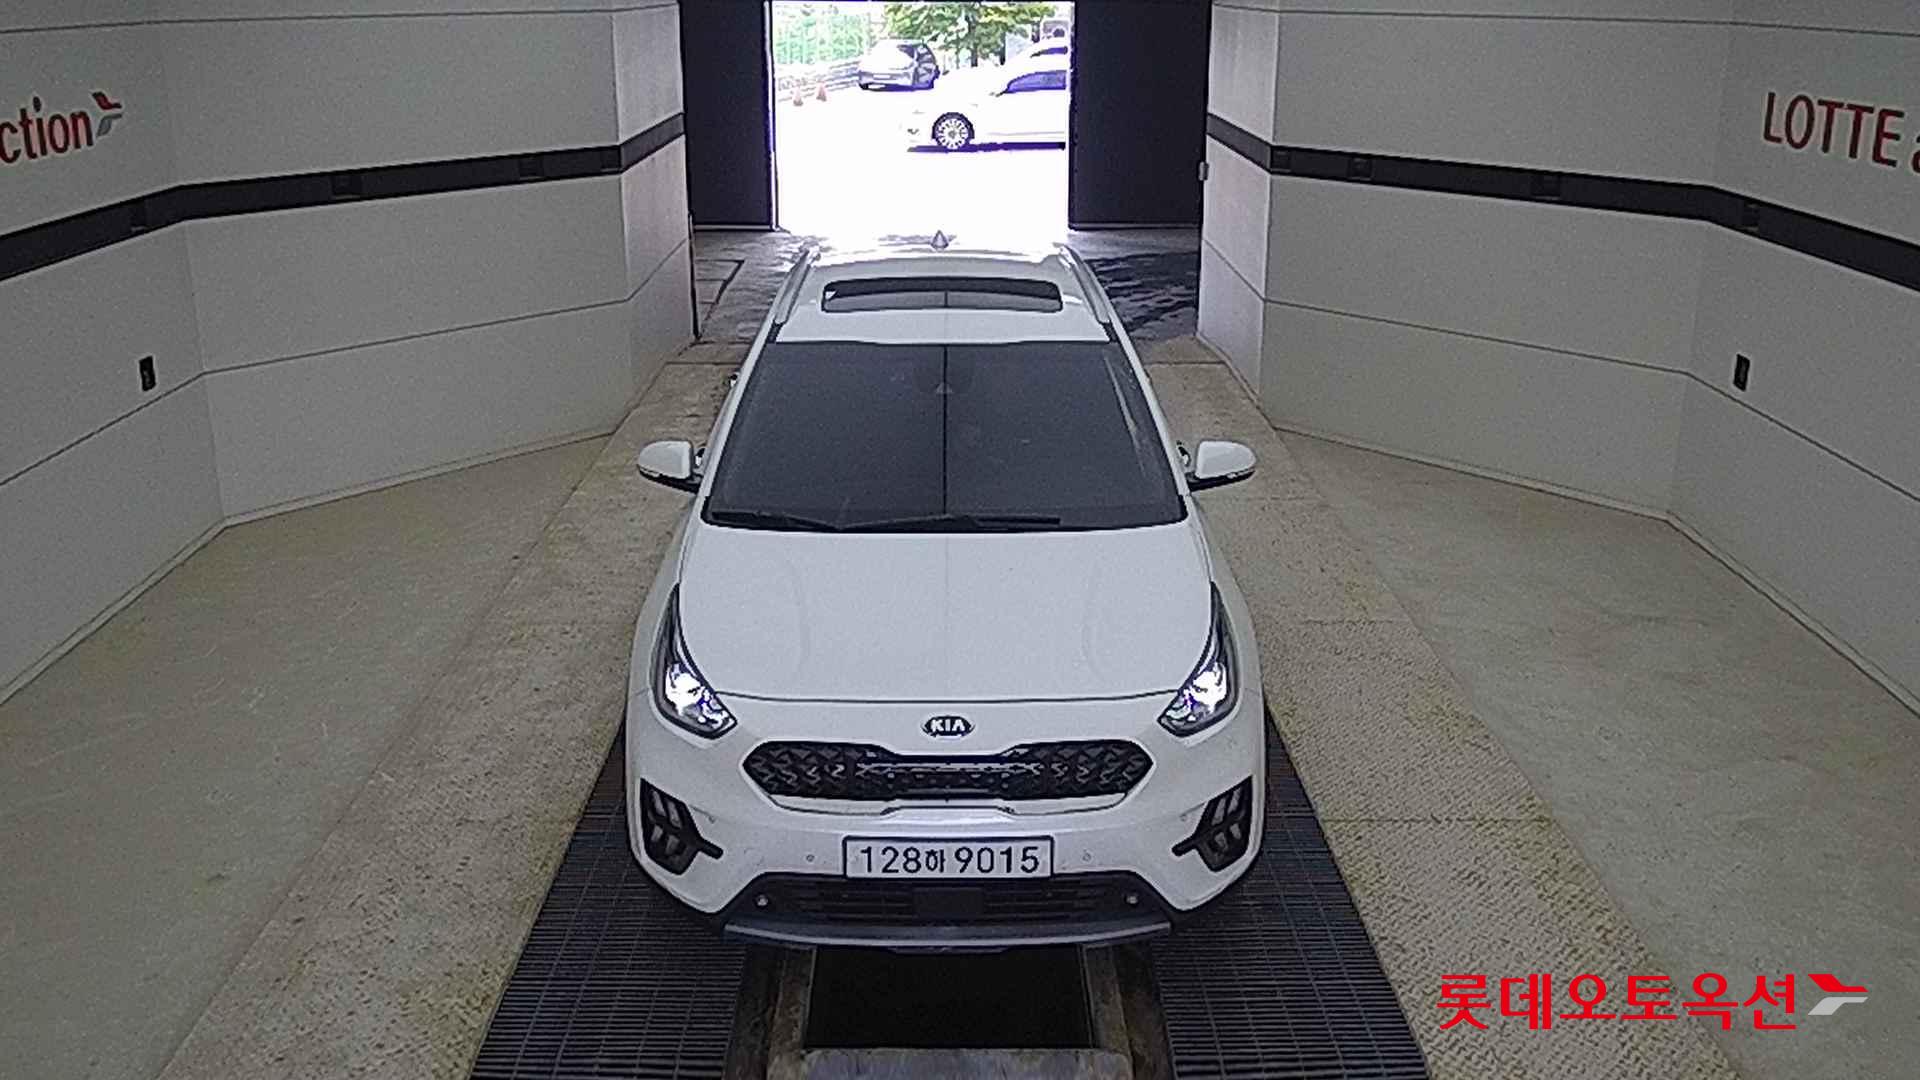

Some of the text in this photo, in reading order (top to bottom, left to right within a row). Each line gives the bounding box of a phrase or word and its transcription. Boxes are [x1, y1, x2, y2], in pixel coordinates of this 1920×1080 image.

[1763, 91, 1905, 168] LOTTE
[930, 718, 966, 732] KIA
[954, 846, 1040, 873] 9015
